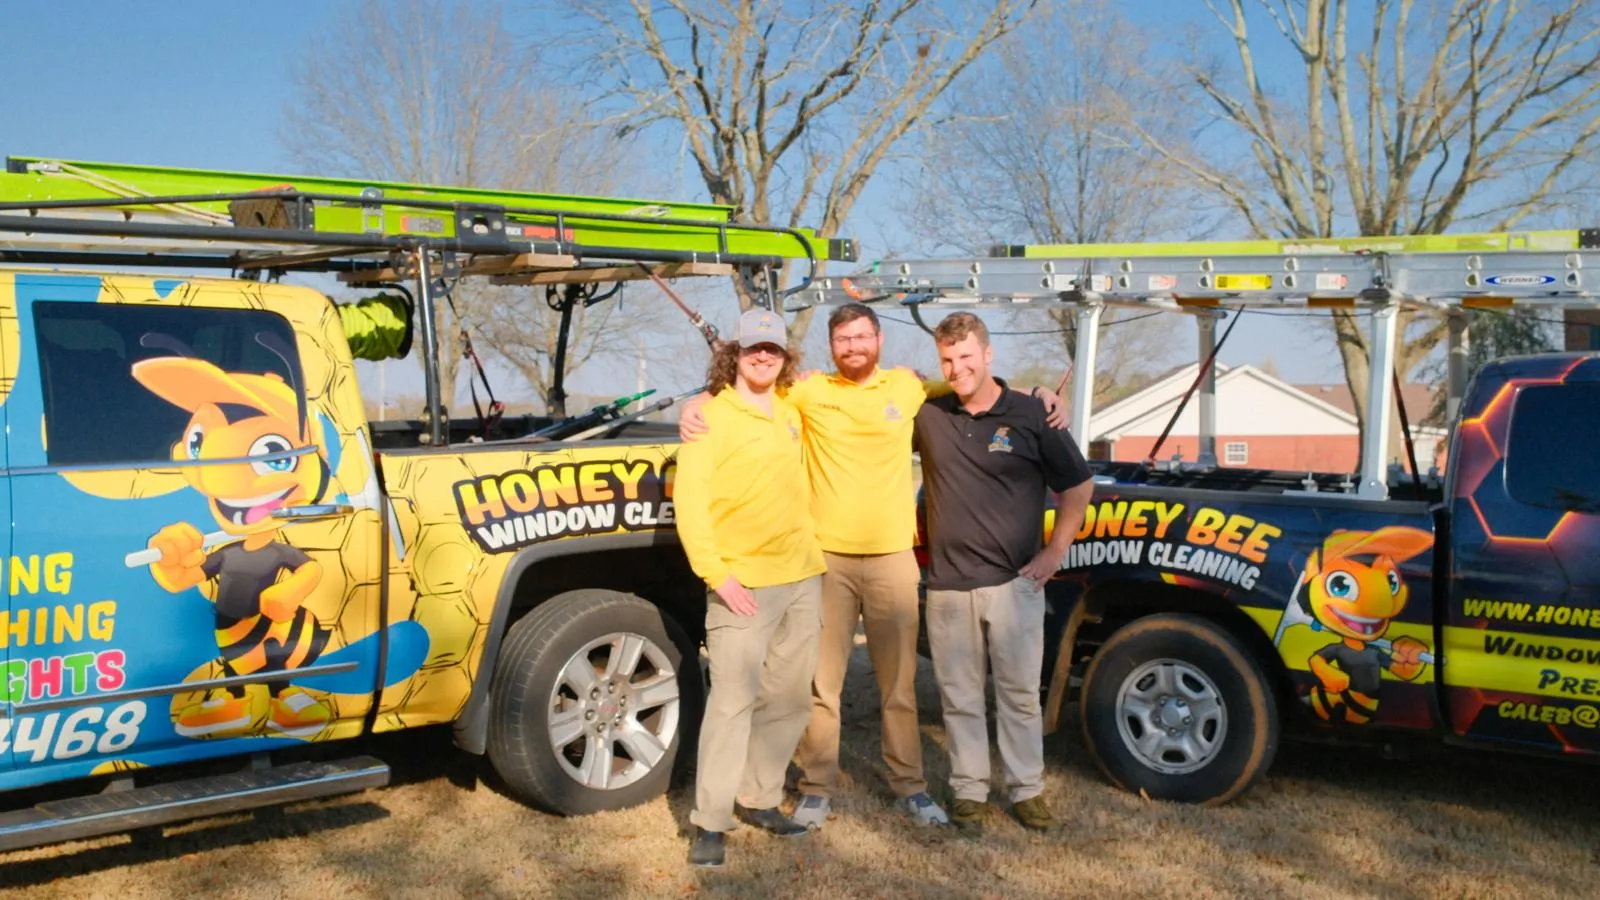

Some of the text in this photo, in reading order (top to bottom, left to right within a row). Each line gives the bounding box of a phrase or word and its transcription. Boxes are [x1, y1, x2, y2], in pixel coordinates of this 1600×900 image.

[459, 462, 649, 525] HONEY
[477, 501, 677, 550] WINDOW CLE
[1186, 507, 1282, 564] BEE
[0, 551, 74, 596] NG
[1149, 542, 1262, 591] CLEANING
[0, 600, 117, 649] HING
[0, 649, 126, 706] GHTS
[1538, 668, 1600, 695] PRE
